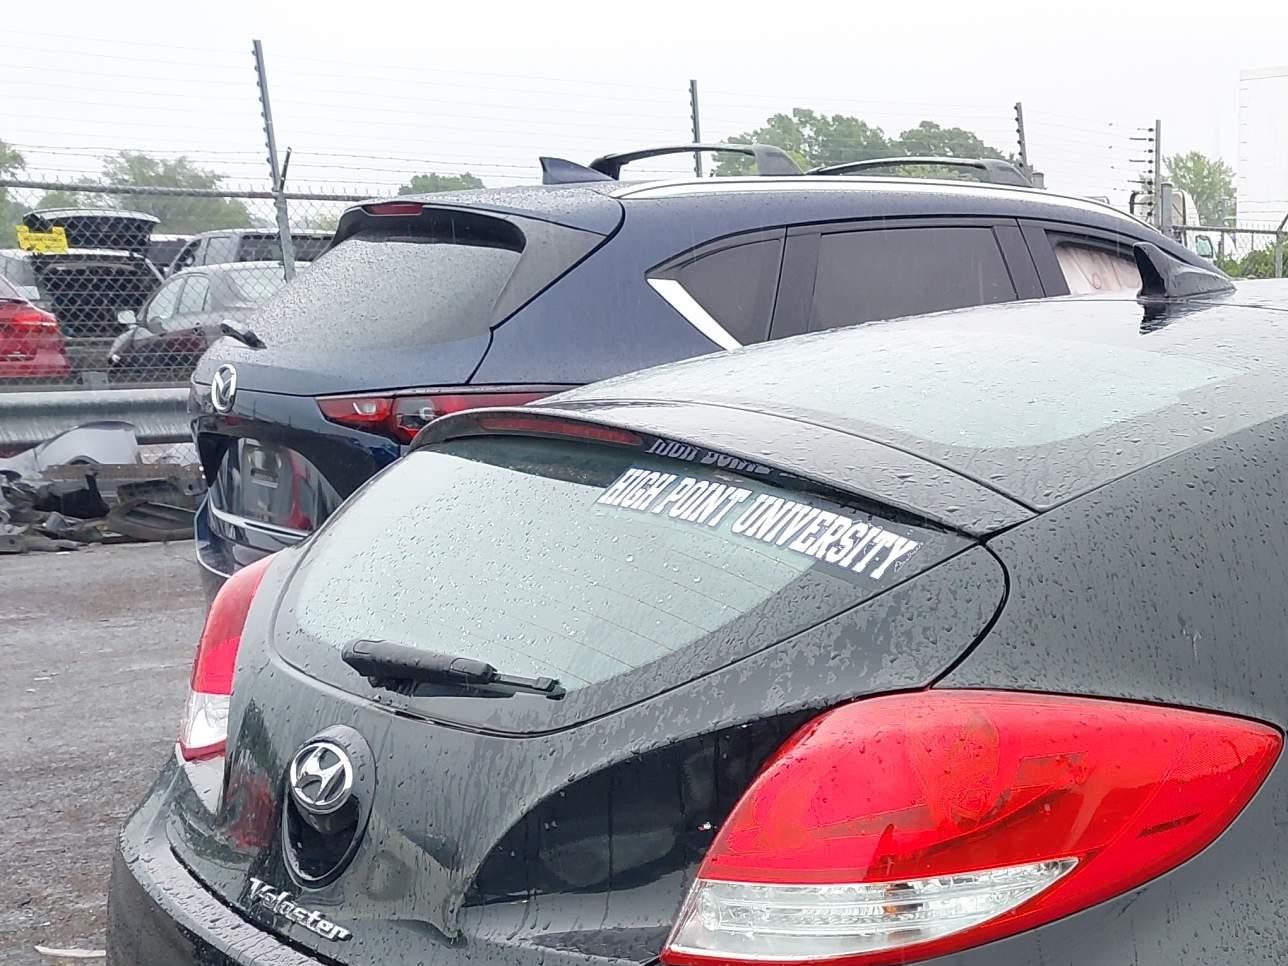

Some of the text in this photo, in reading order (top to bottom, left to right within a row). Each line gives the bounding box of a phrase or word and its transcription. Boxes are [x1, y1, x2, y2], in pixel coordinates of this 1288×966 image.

[597, 468, 678, 514] HIGH
[663, 477, 752, 527] POINT
[731, 494, 919, 580] UNIVERSITY
[250, 877, 353, 940] Veloster
